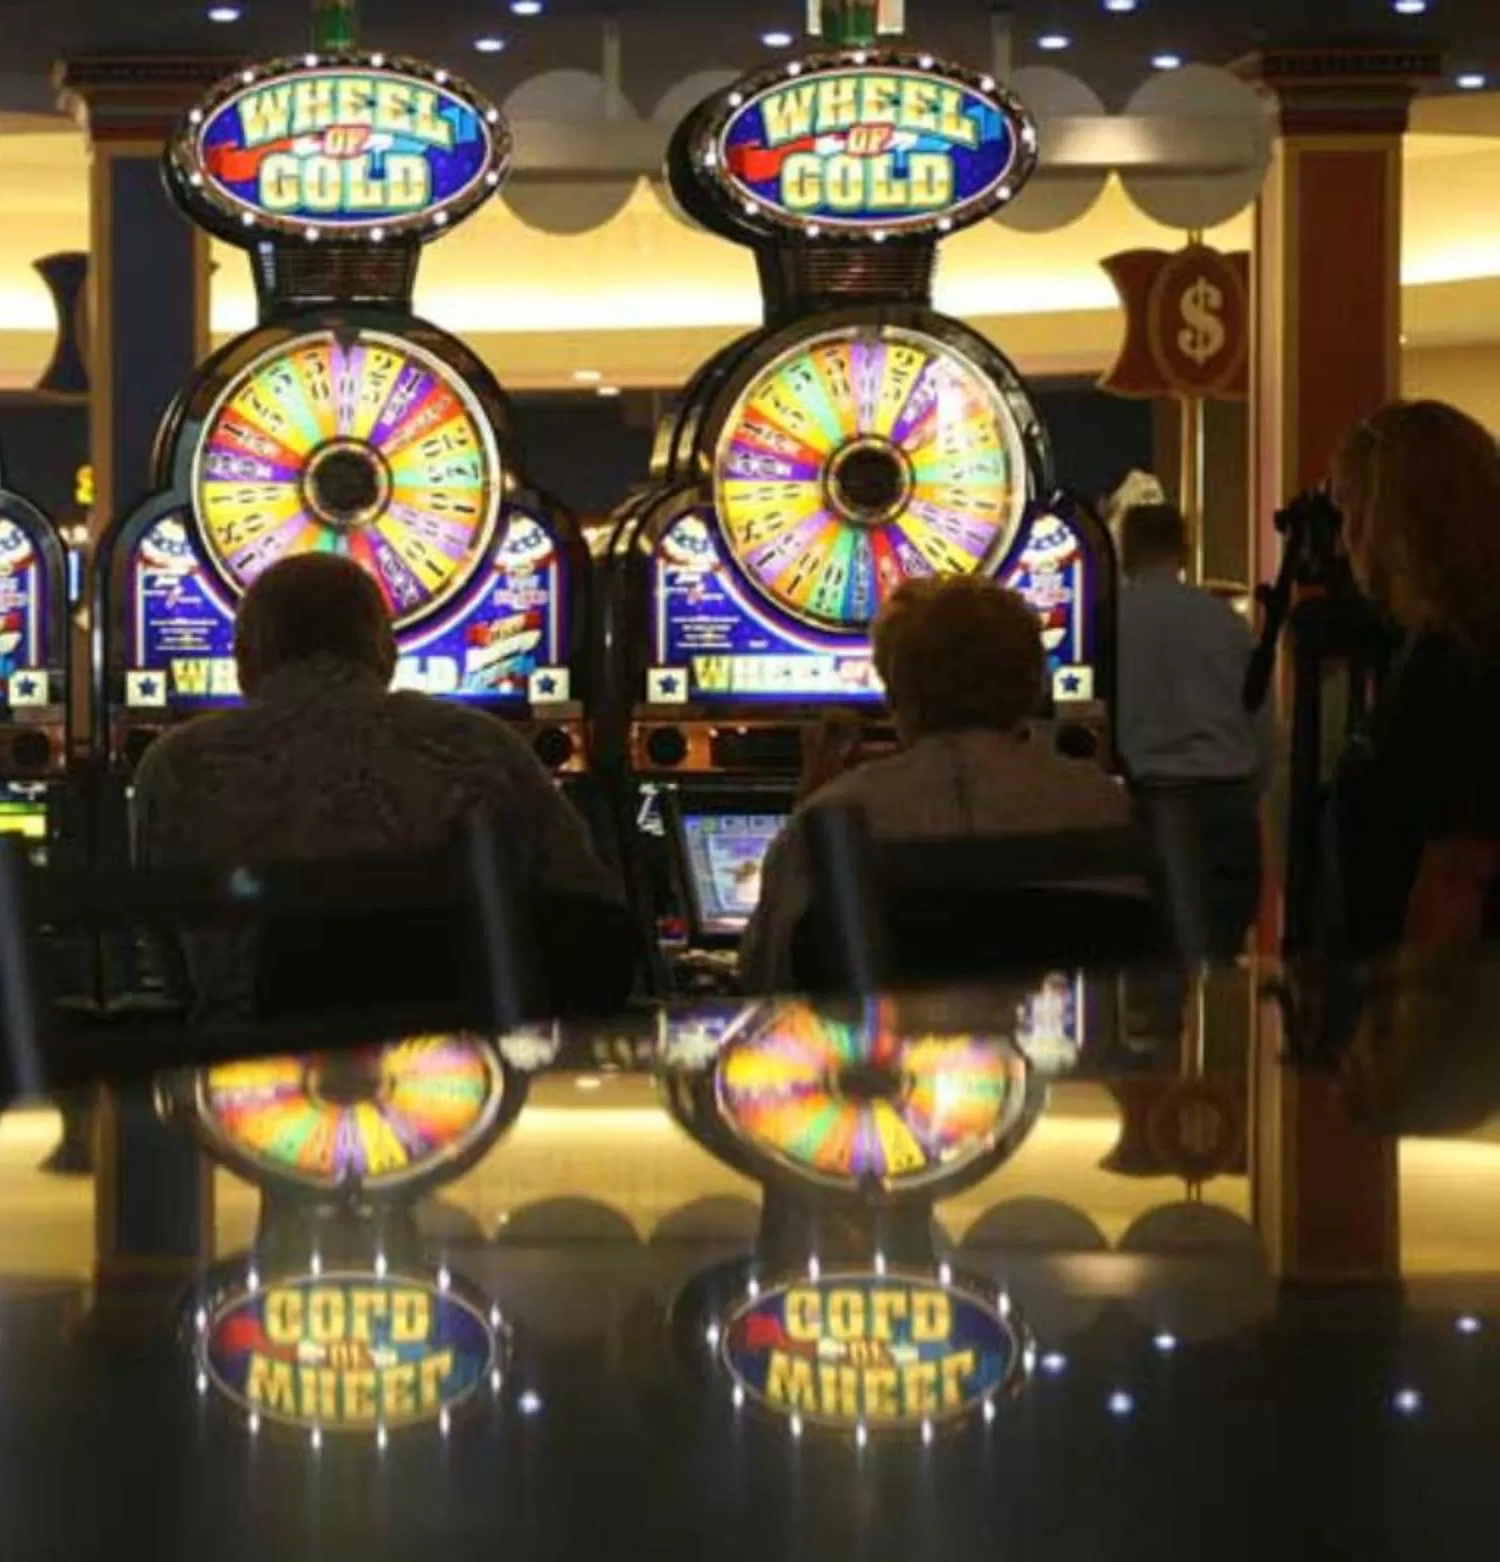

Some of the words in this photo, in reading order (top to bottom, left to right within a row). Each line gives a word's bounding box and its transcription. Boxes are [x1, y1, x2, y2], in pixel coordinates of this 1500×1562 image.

[236, 77, 455, 149] WHEEL
[325, 127, 367, 157] OF
[760, 76, 979, 150] WHEEL
[849, 125, 891, 155] OF
[259, 152, 431, 212] GOLD
[780, 151, 956, 212] GOLD
